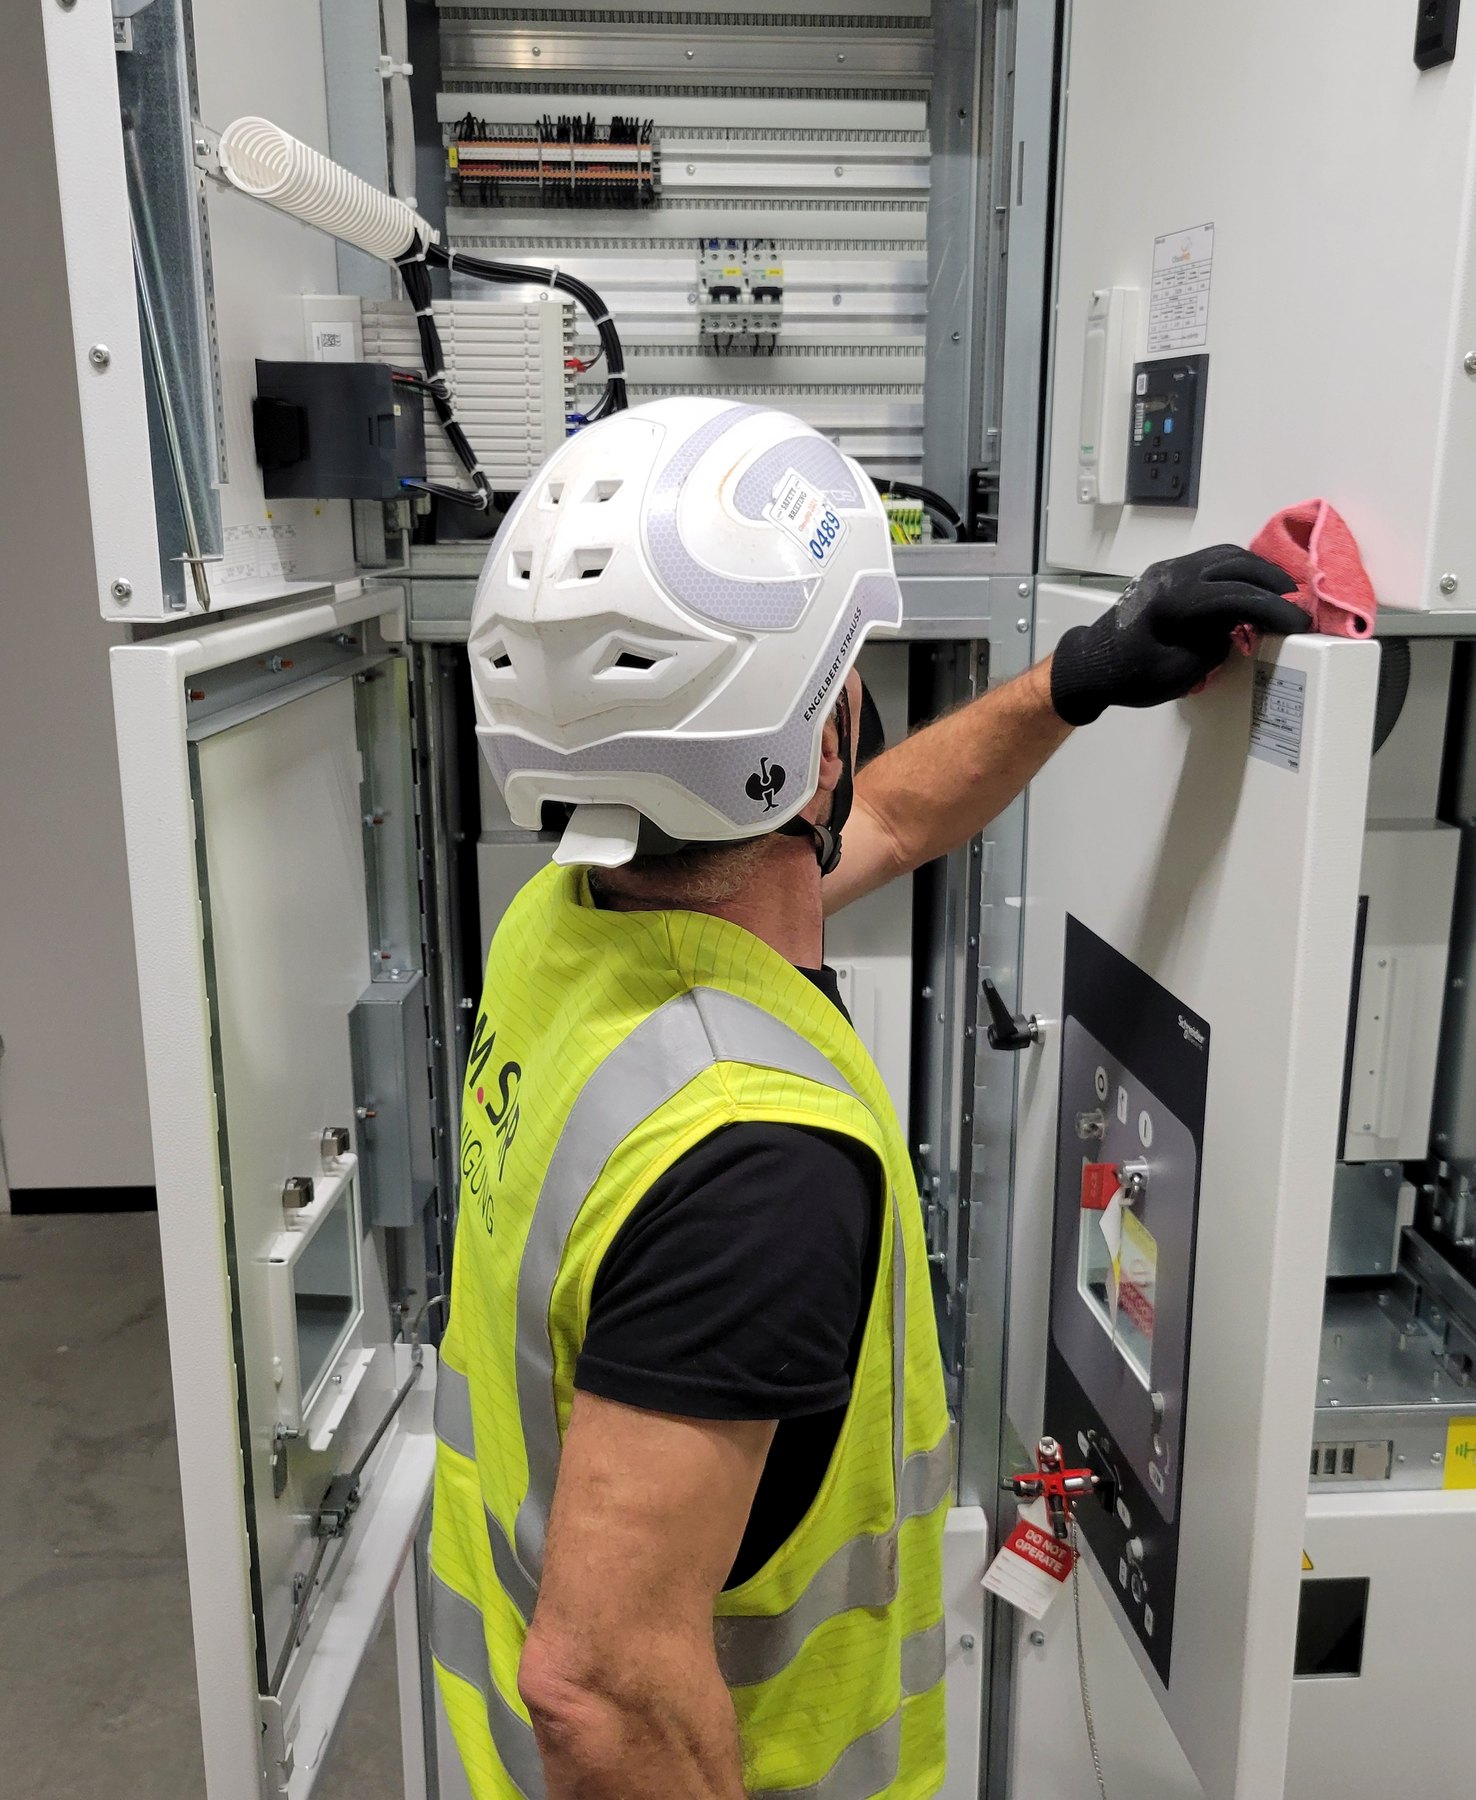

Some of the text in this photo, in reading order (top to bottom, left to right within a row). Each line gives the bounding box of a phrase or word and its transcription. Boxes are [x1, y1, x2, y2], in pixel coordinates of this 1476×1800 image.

[781, 487, 797, 510] SAFETY
[788, 491, 807, 520] BRIEFING
[809, 511, 840, 559] 0489
[803, 606, 862, 722] ENGELBERT STRAUSS
[1015, 1538, 1063, 1573] OPERATE
[1025, 1529, 1067, 1558] DO NOT
